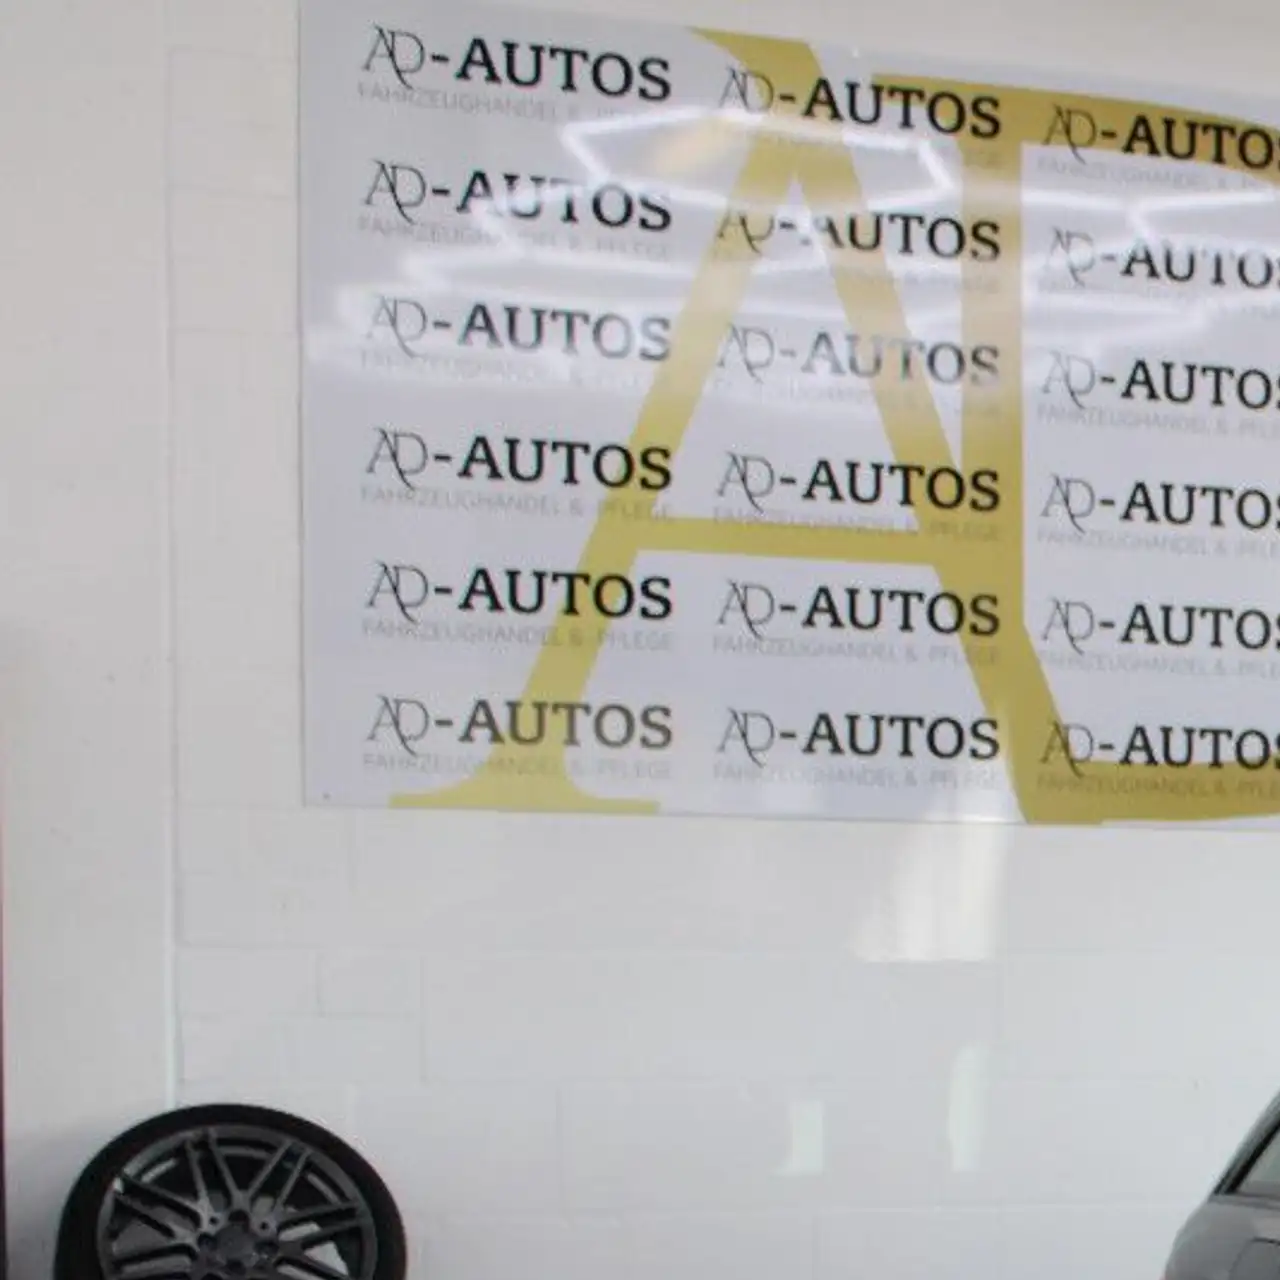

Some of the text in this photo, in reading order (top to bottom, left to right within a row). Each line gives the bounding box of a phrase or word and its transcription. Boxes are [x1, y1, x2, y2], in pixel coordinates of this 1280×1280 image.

[362, 24, 672, 100] AD-AUTOS
[716, 68, 1000, 139] AD-AUTOS
[366, 297, 672, 360] AD-AUTOS
[364, 427, 672, 491] AD-AUTOS
[716, 452, 1000, 513] AD-AUTOS
[365, 560, 672, 625] AD-AUTOS
[716, 580, 1000, 639] AD-AUTOS
[366, 695, 672, 755] AD-AUTOS
[716, 709, 1000, 766] AD-AUTOS
